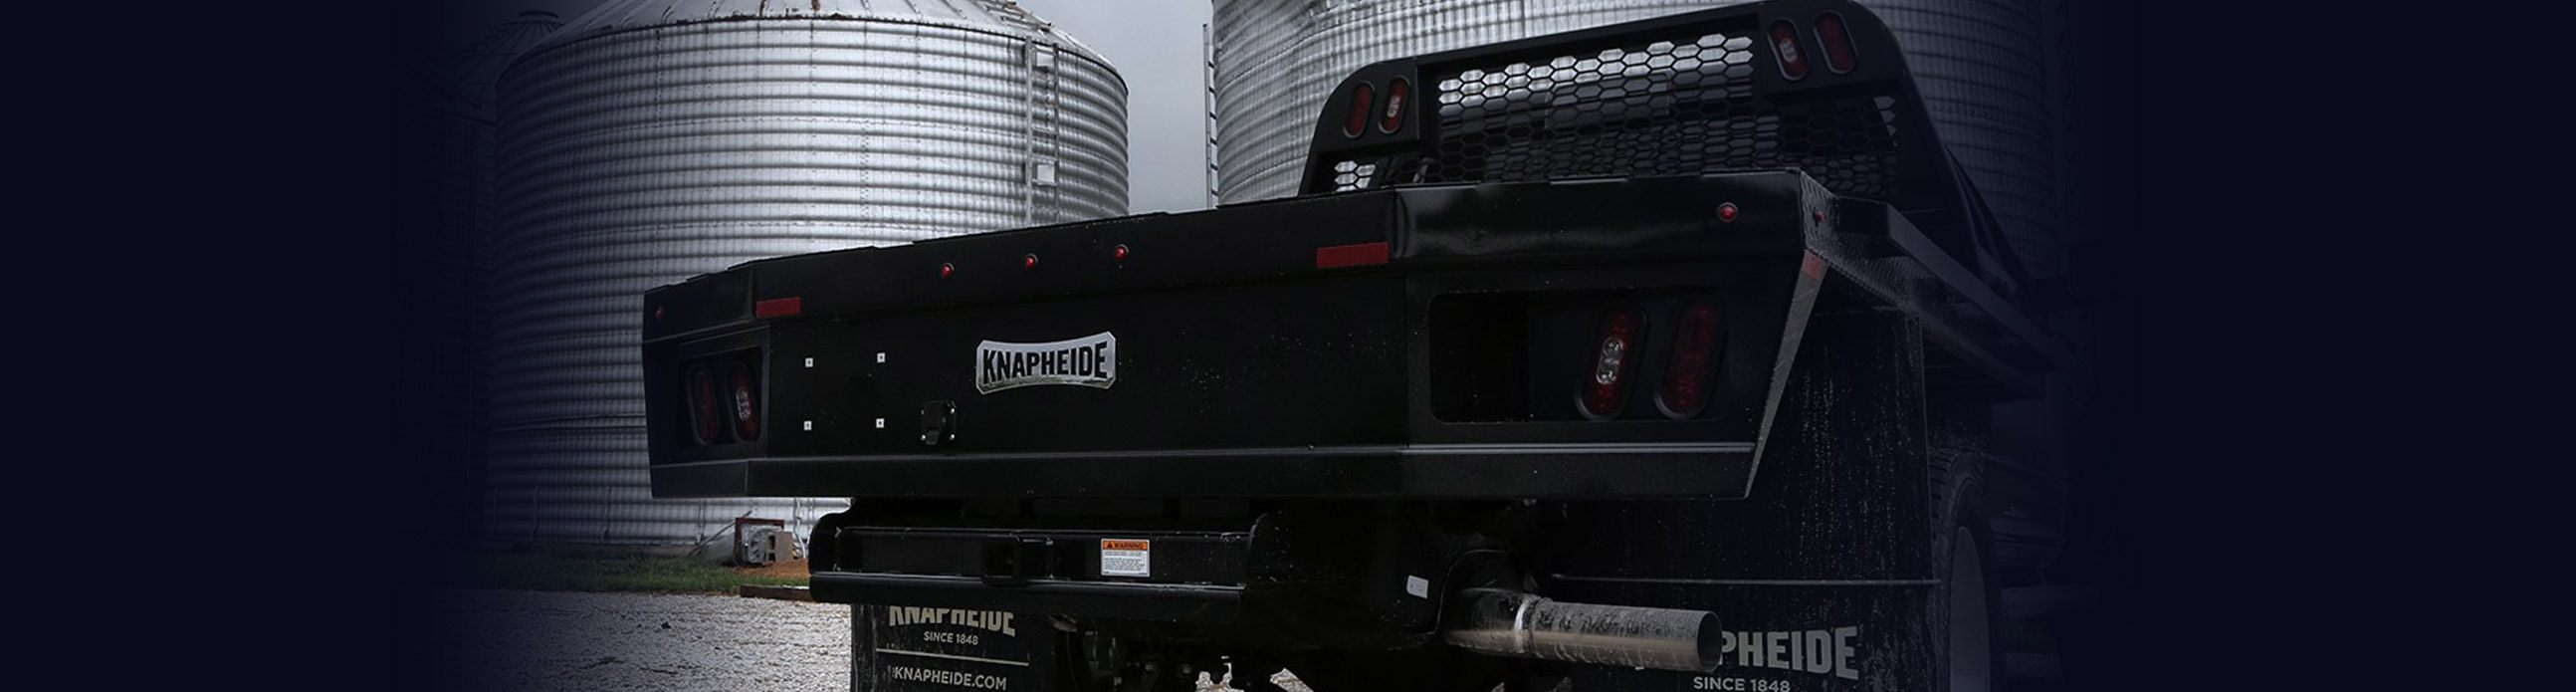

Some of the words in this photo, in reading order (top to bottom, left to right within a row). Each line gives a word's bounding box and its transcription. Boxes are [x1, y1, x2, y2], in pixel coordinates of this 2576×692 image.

[983, 342, 1107, 383] KNAPHEIDE
[924, 631, 954, 643] SINCE
[956, 634, 979, 646] 1848
[1719, 625, 1859, 680] PHEIDE
[895, 666, 1007, 691] KNAPHEIDE.COM
[1693, 677, 1746, 691] SINCE
[1750, 679, 1791, 692] 1848
